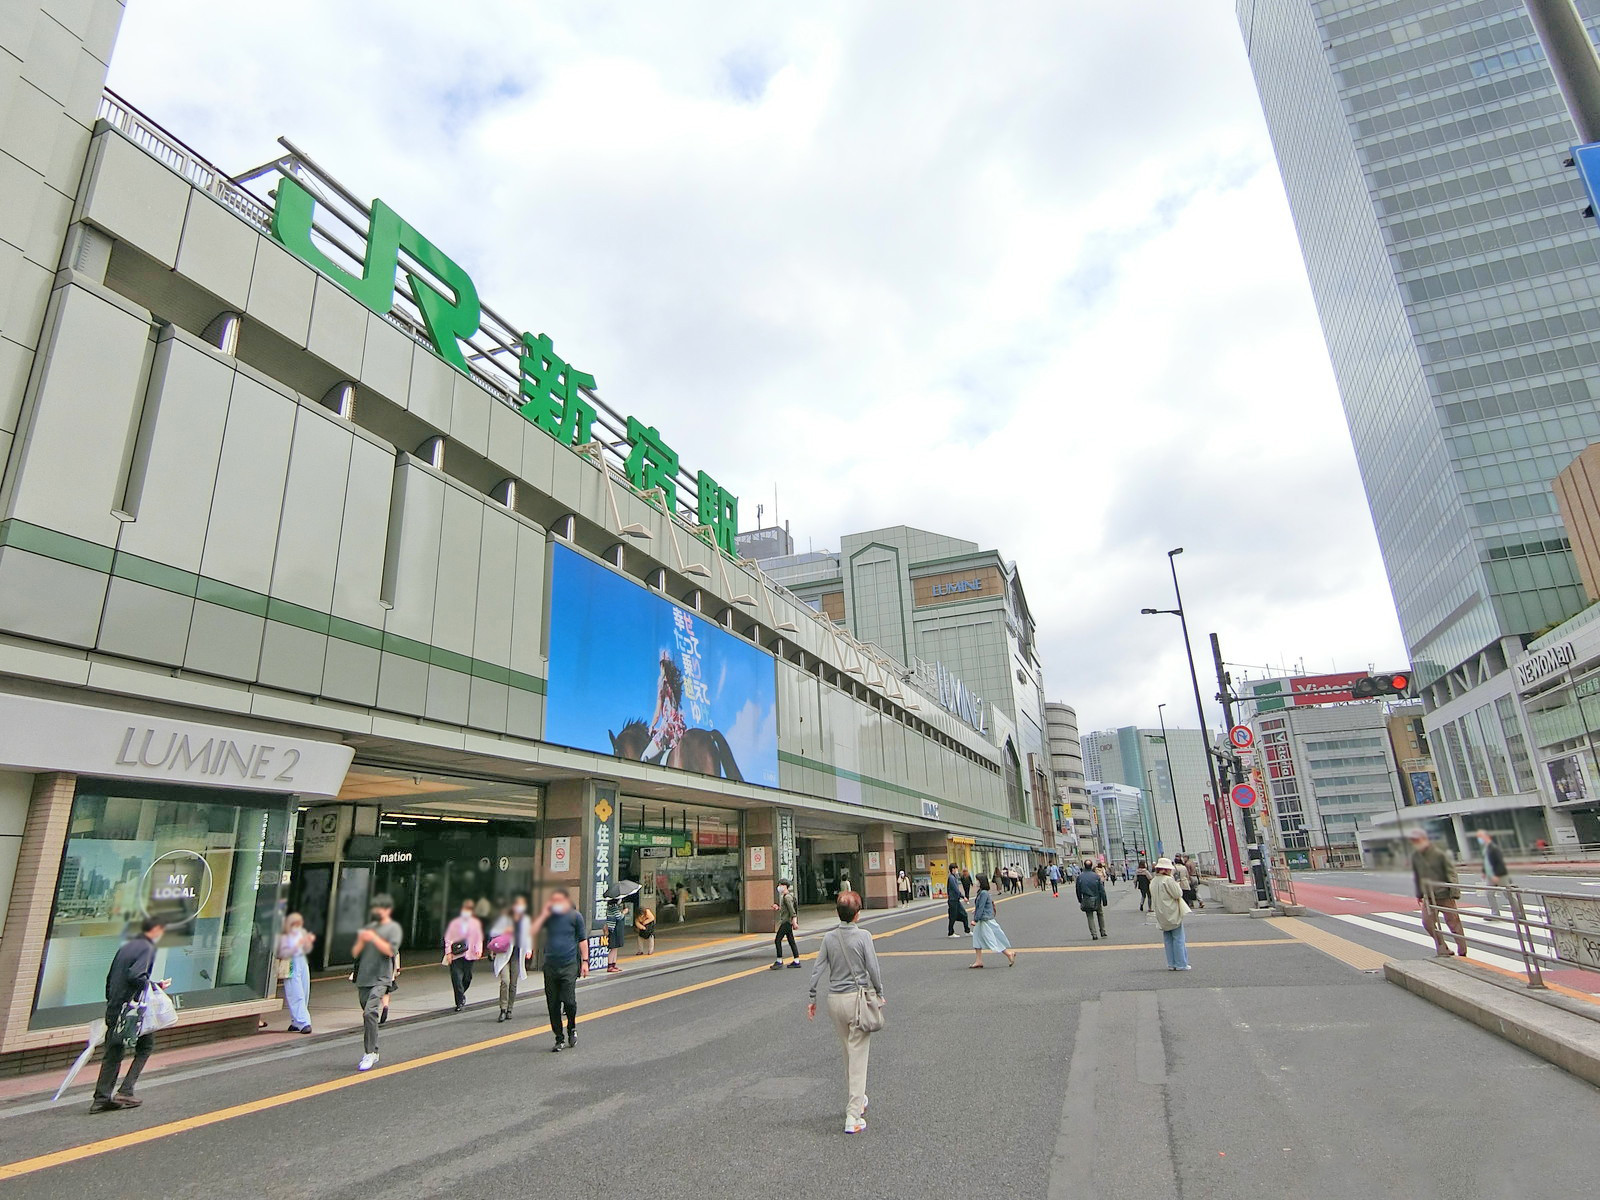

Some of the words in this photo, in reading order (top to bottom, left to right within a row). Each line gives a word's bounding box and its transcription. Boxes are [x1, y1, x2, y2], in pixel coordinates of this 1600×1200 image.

[519, 331, 739, 558] 新宿駅
[932, 578, 982, 597] LUMINE
[1297, 680, 1354, 696] Victori
[115, 727, 275, 780] LUMINE
[274, 748, 301, 782] 2
[168, 874, 189, 885] MY
[596, 824, 609, 921] 住友不動産
[154, 887, 196, 898] LOCAL
